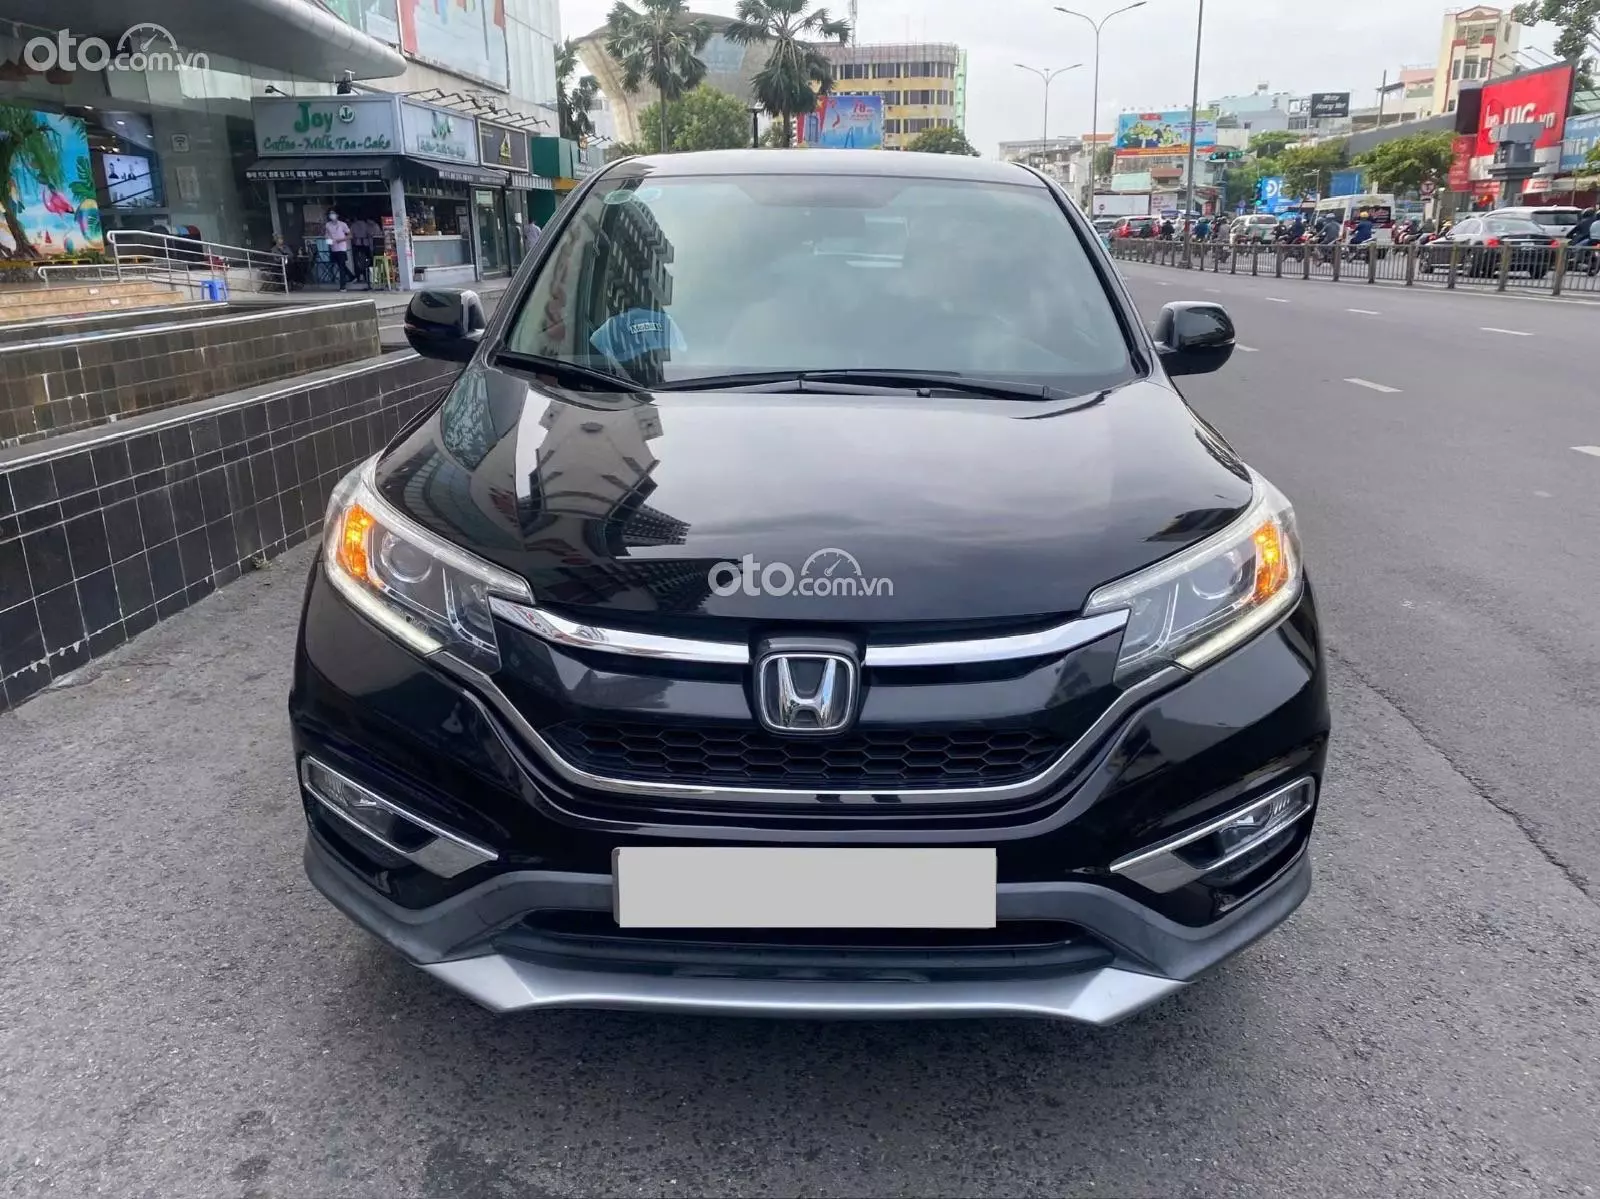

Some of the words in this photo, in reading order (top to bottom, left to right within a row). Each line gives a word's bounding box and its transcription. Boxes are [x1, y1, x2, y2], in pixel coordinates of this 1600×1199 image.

[294, 101, 333, 133] Joy
[263, 135, 296, 152] Coffee
[304, 134, 334, 150] Milk
[336, 137, 357, 150] Tea
[364, 134, 391, 150] Cake
